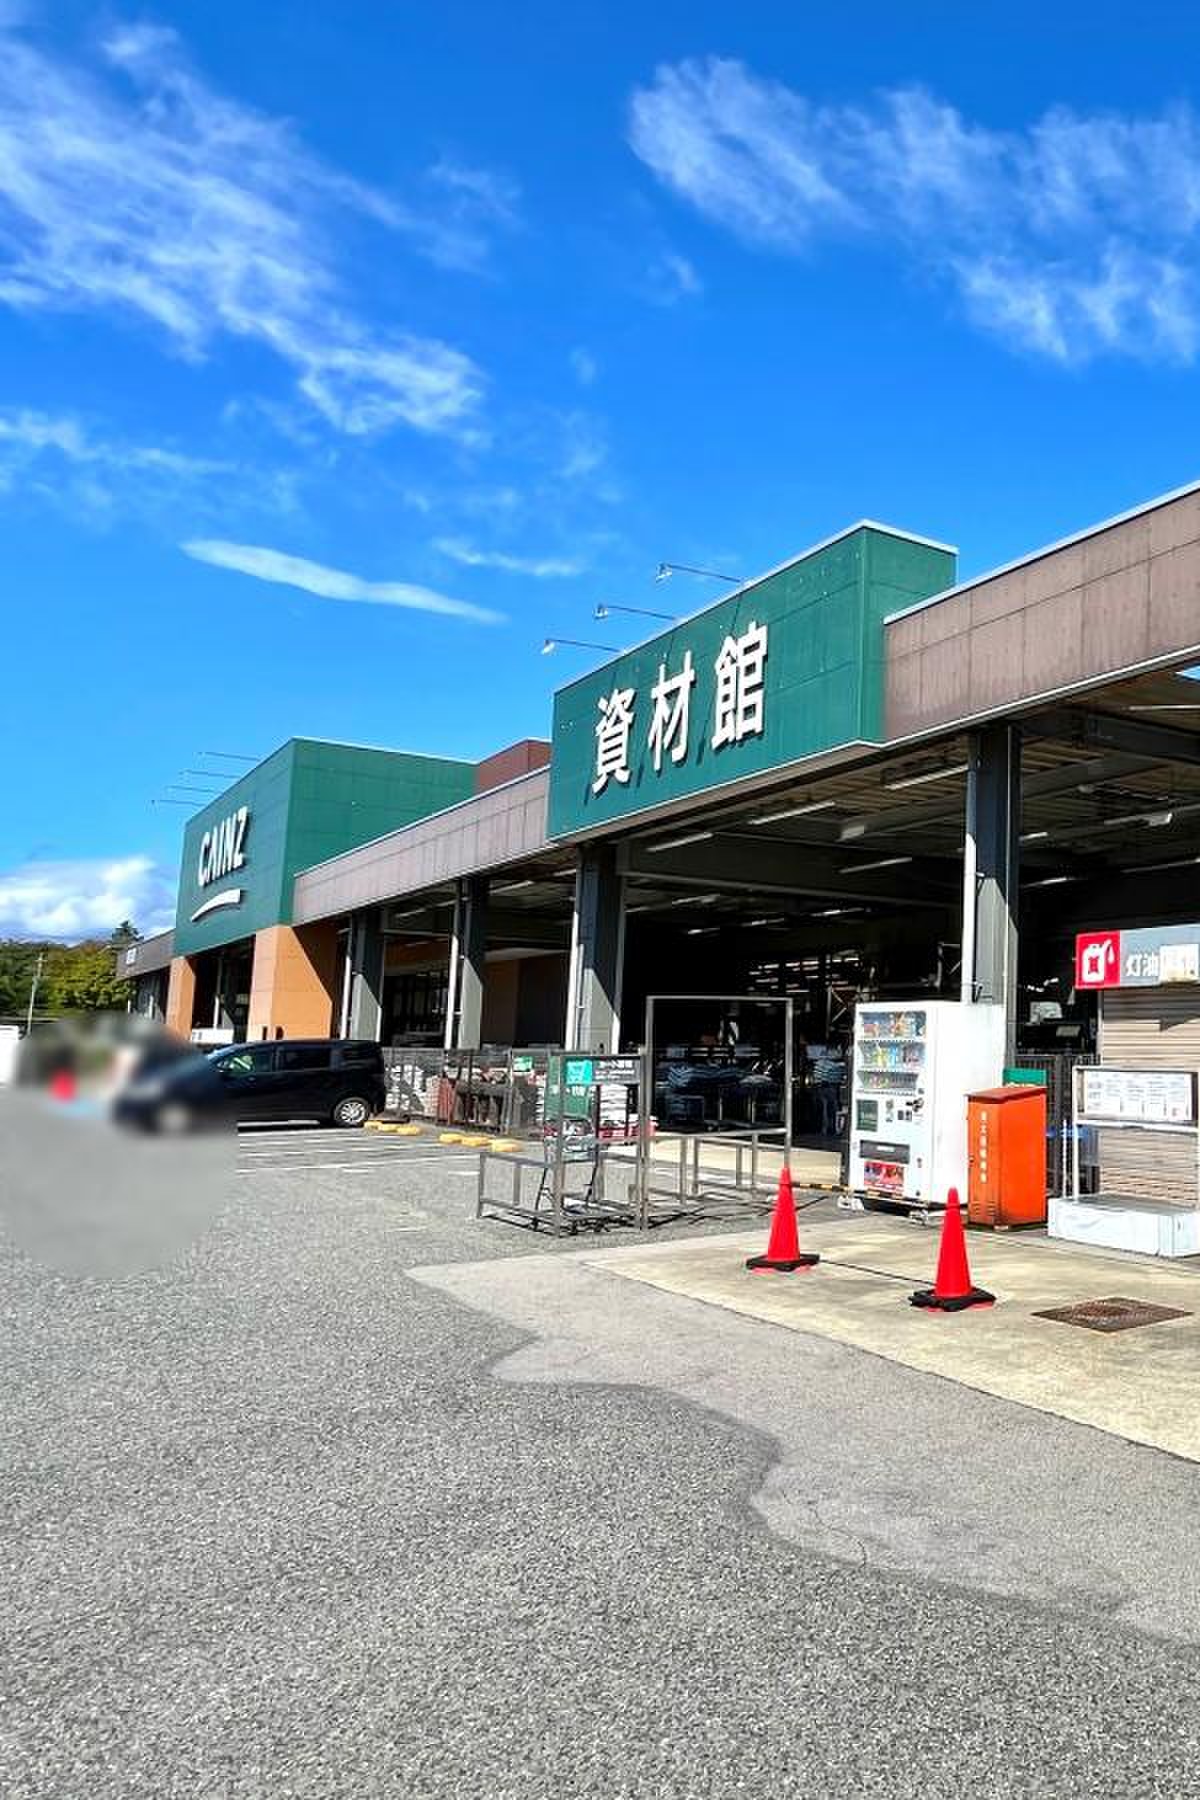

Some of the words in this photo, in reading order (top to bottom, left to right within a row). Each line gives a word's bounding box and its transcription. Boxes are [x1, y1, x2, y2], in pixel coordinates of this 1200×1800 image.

[592, 621, 768, 795] 資材館
[198, 805, 248, 887] CAINZ
[1126, 951, 1160, 977] 灯油
